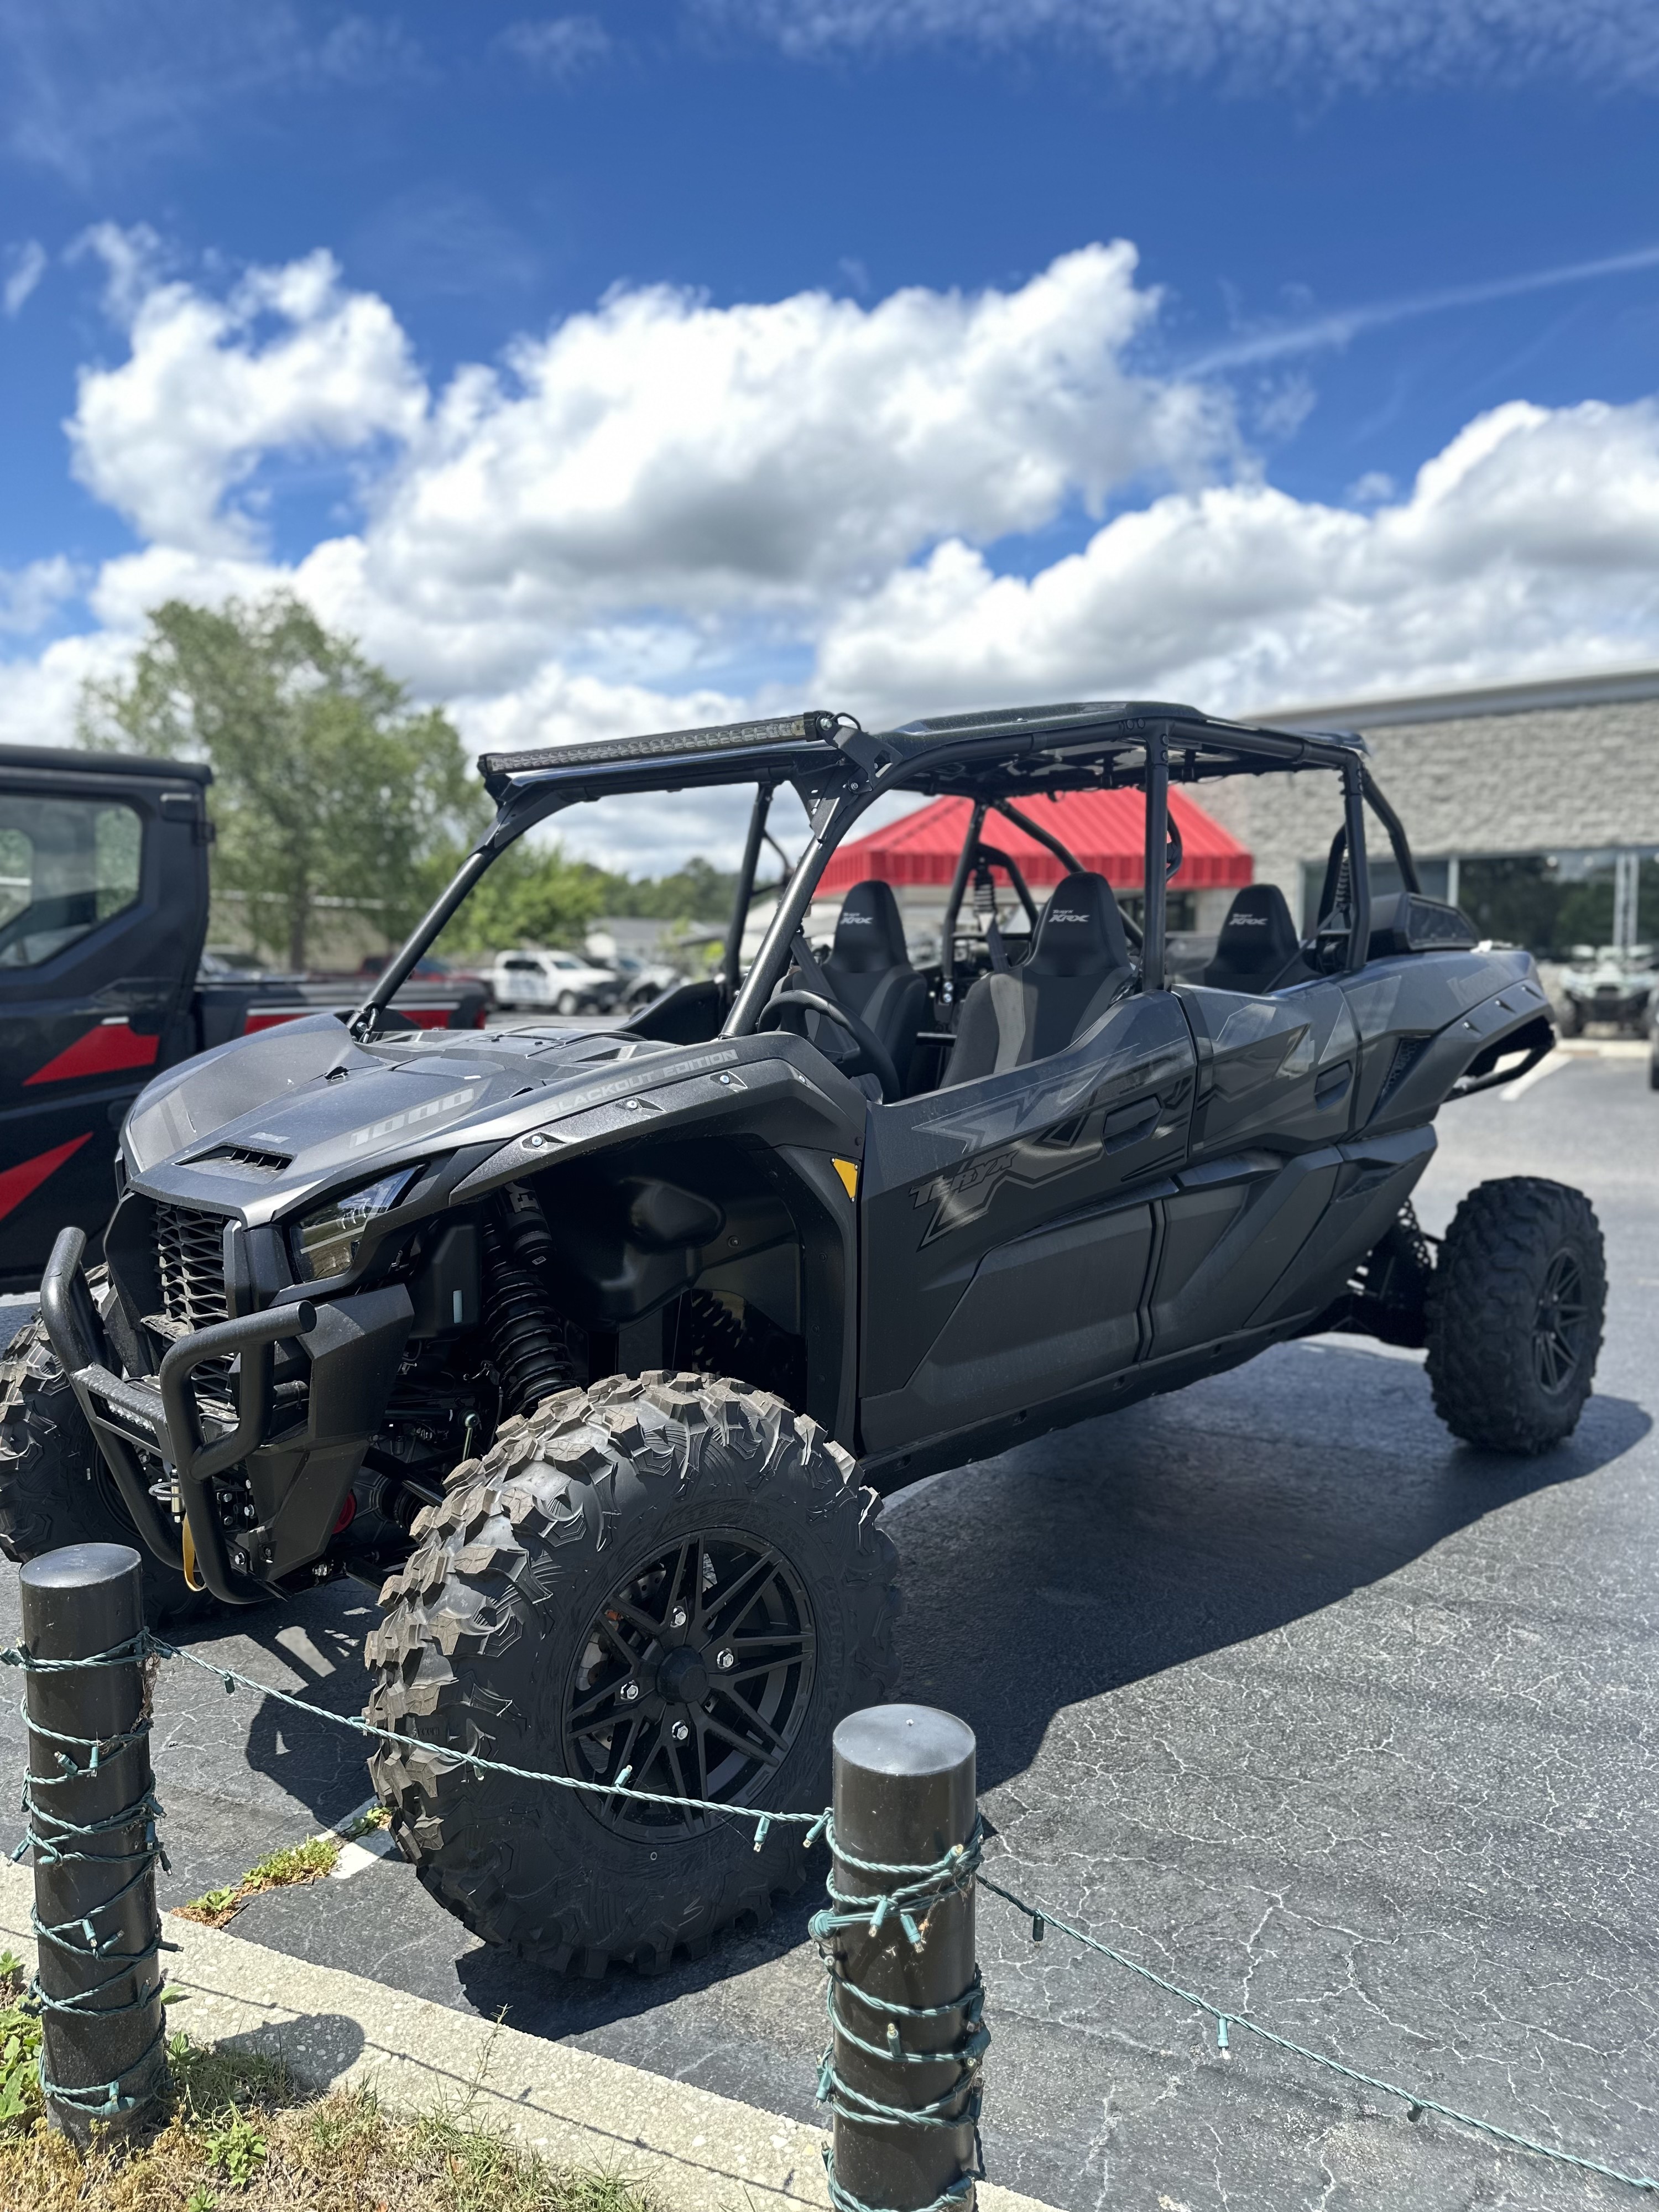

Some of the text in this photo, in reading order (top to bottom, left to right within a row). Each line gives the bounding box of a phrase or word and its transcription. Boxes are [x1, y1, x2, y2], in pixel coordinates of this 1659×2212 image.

[840, 916, 873, 925] KRX
[1048, 914, 1090, 922] KRX
[542, 1048, 739, 1118] BLACKOUT EDITION
[349, 1088, 474, 1149] 1000
